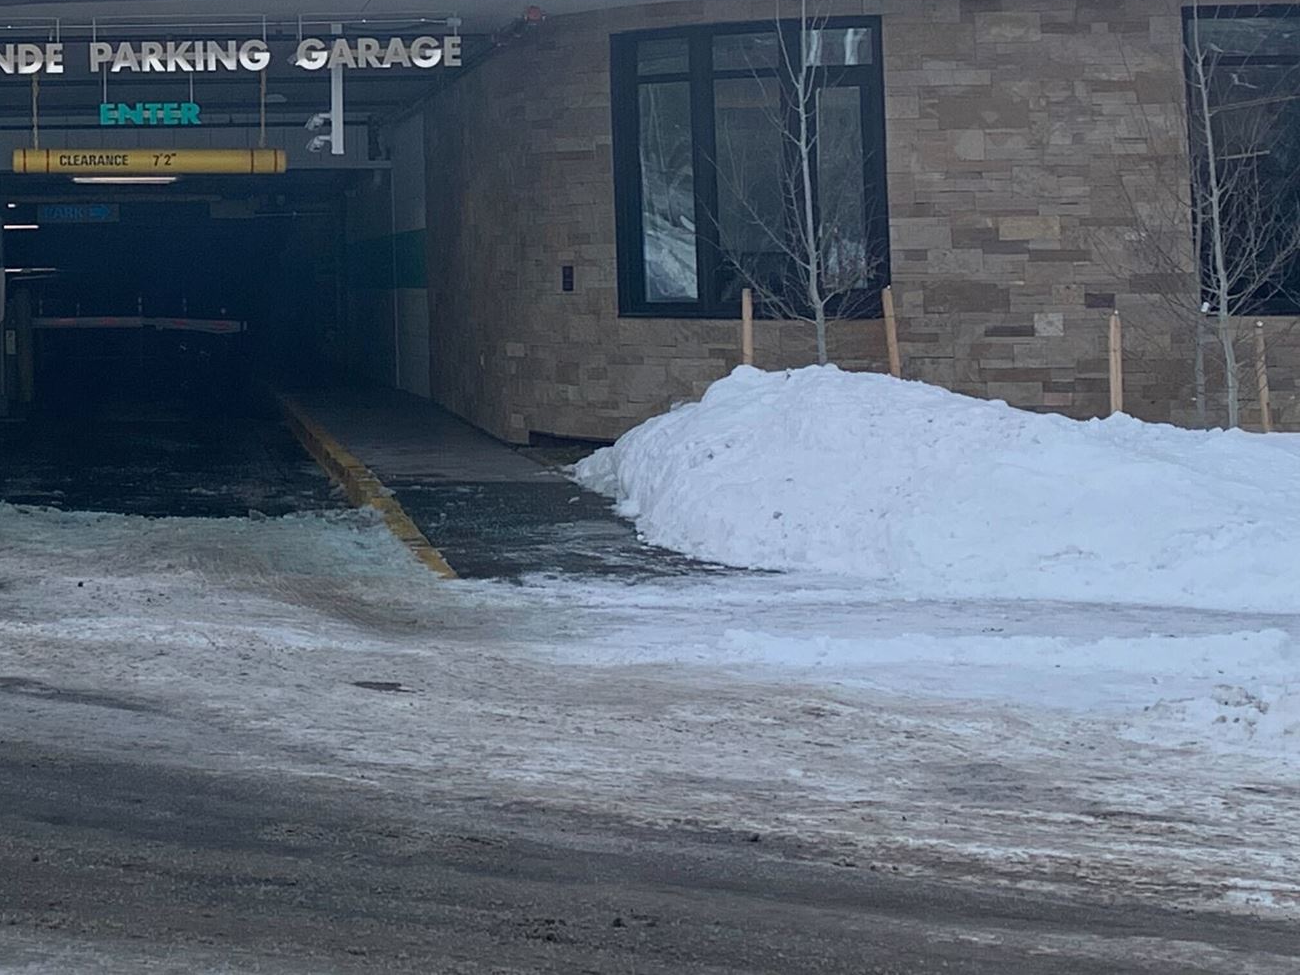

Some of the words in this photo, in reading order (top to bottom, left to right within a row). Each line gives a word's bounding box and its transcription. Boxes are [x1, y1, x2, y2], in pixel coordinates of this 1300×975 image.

[89, 39, 271, 73] PARKING
[295, 36, 462, 69] GARAGE
[101, 103, 201, 125] ENTER
[59, 154, 129, 167] CLEARANCE
[44, 207, 84, 219] PARK
